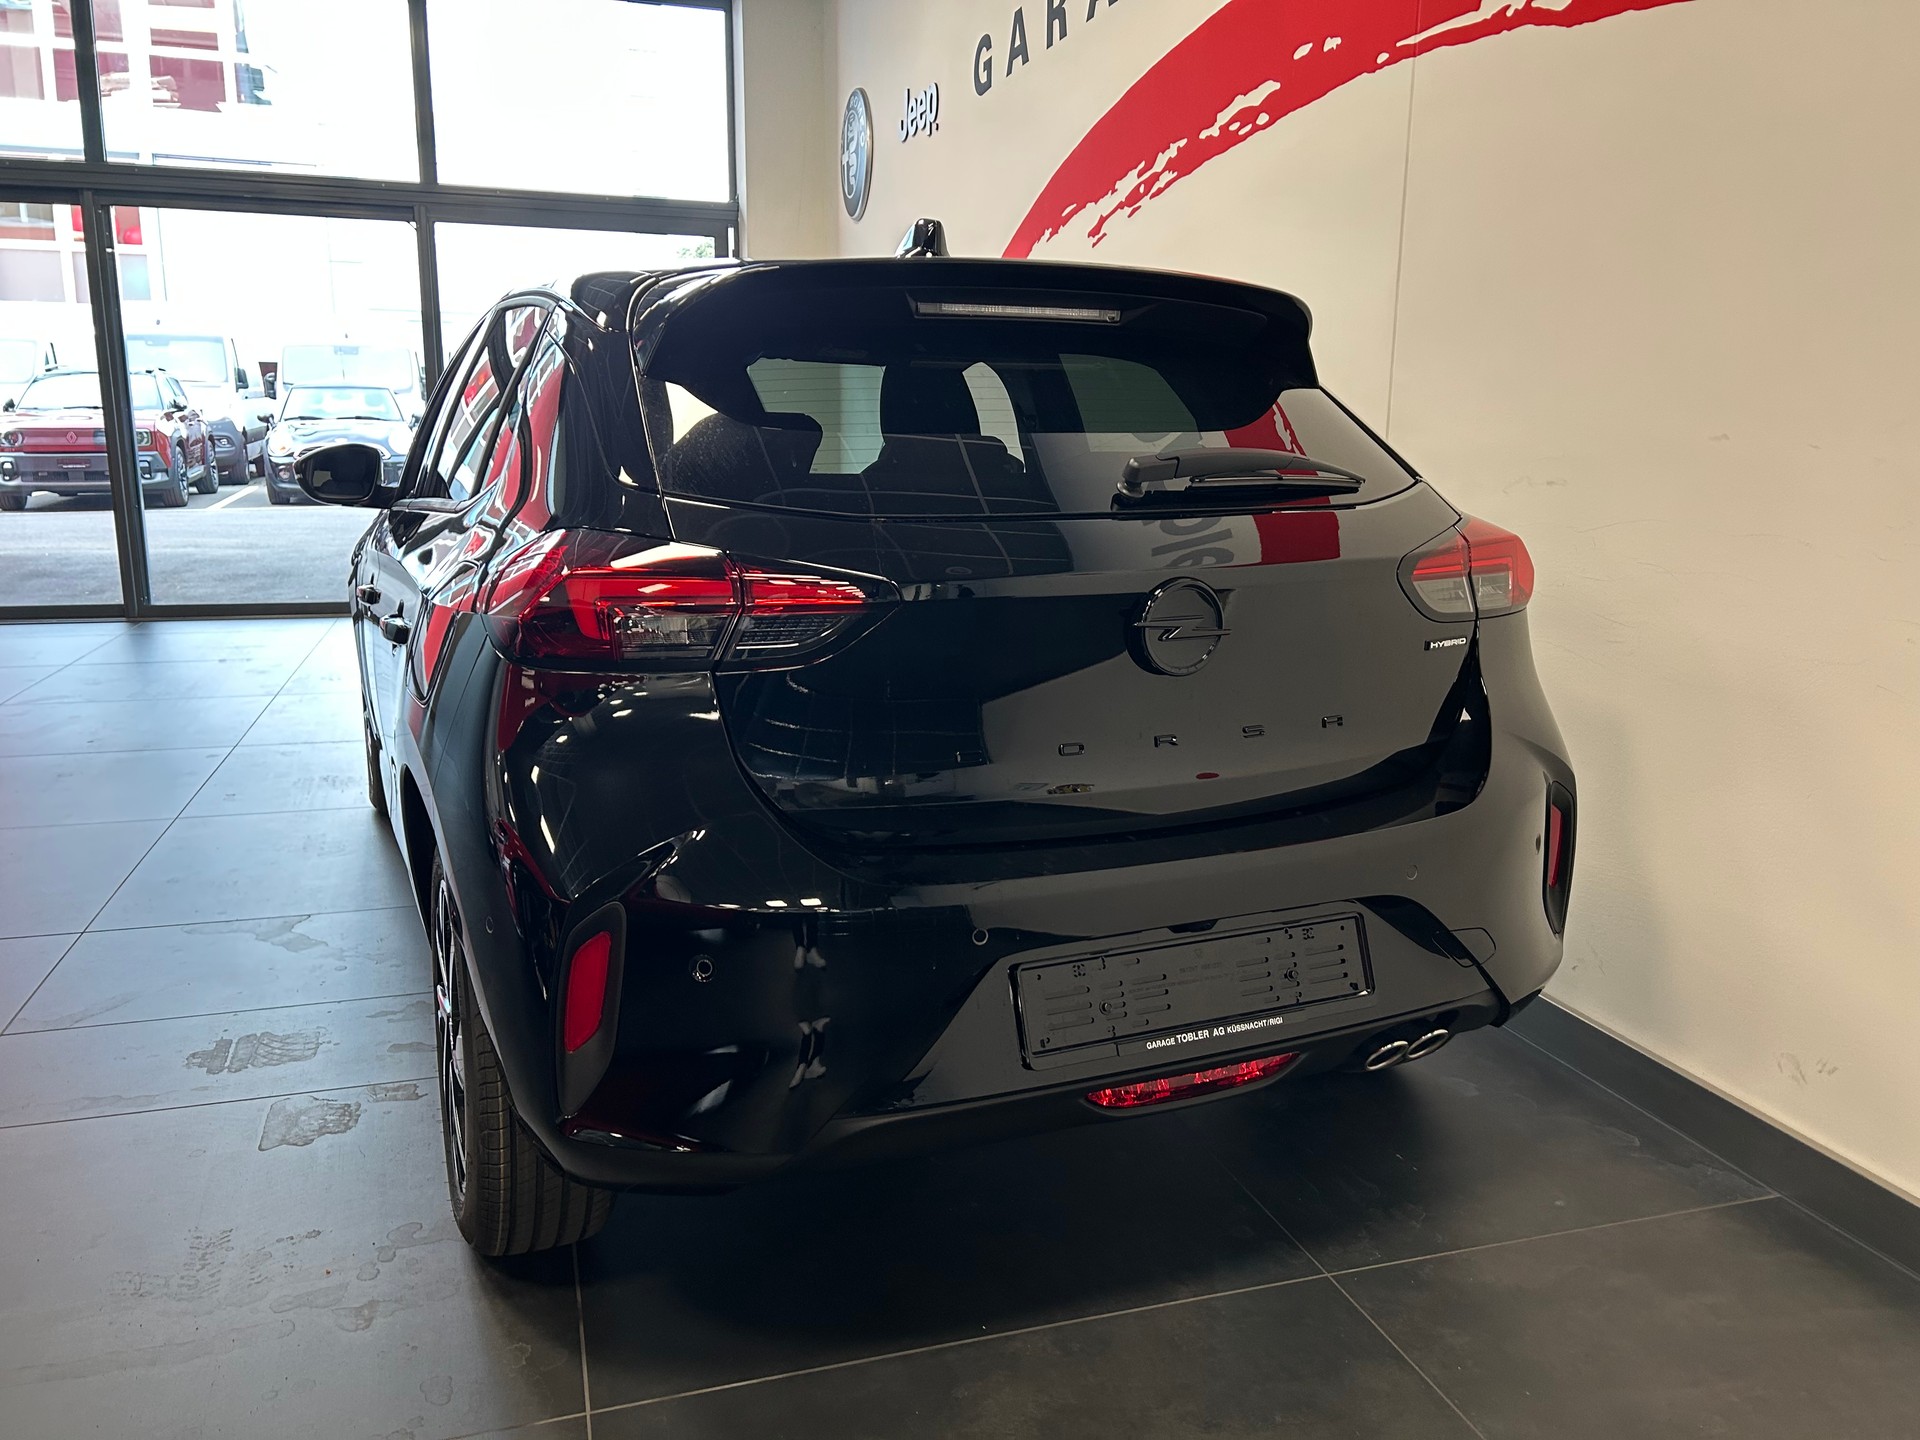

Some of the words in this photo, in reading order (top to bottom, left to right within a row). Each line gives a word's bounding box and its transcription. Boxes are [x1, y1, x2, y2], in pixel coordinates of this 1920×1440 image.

[974, 0, 1118, 96] GAR
[900, 82, 939, 143] Jeep
[1430, 637, 1467, 649] HYBRID
[1146, 1037, 1176, 1050] GARAGE
[1176, 1029, 1210, 1044] TOBLER
[1213, 1026, 1225, 1037] AG
